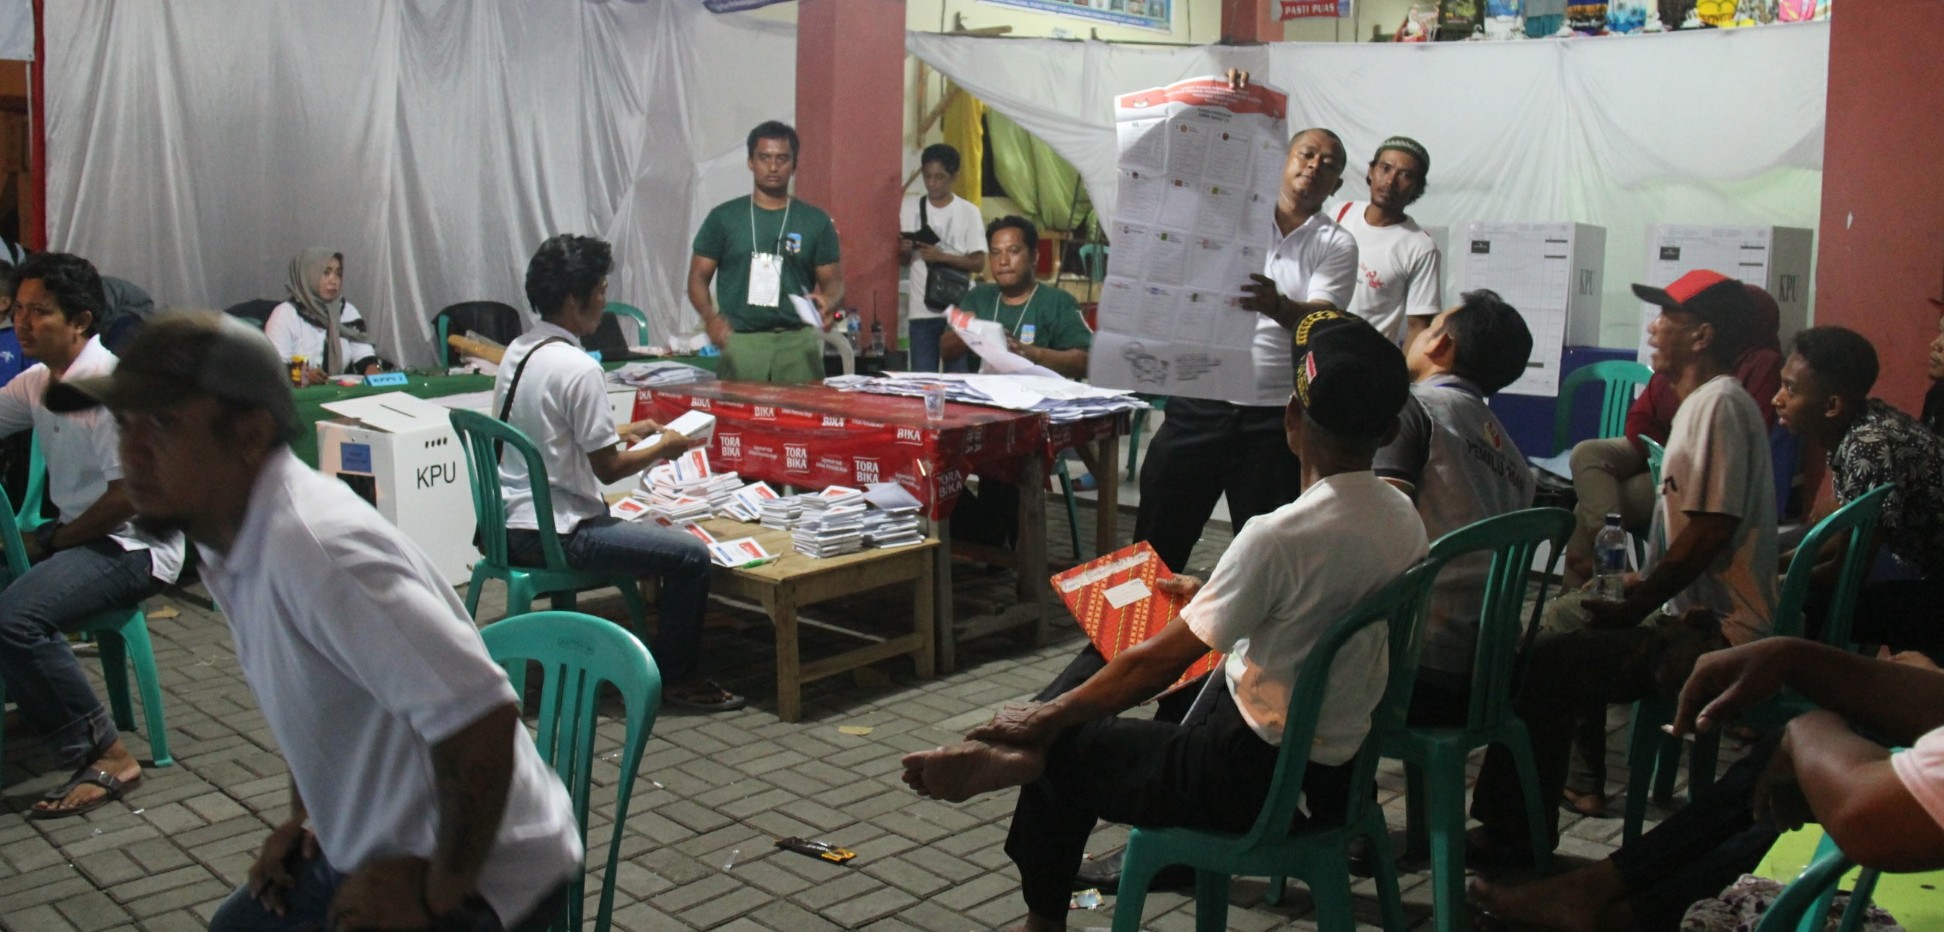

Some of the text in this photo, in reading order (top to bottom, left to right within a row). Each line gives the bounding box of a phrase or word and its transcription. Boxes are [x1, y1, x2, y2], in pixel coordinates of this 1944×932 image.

[1285, 3, 1335, 15] PASTI PUAS
[1578, 268, 1596, 296] KPU
[1779, 273, 1800, 303] KPU
[754, 406, 775, 417] BIKA
[821, 416, 845, 427] BIKA
[896, 428, 921, 441] BIKA
[720, 436, 741, 447] TORA
[721, 446, 741, 457] BIKA
[785, 446, 807, 459] TORA
[786, 457, 807, 469] BIKA
[855, 460, 879, 473] TORA
[416, 461, 457, 490] KPU
[856, 471, 879, 484] BIKA
[937, 469, 962, 486] TORA
[938, 480, 963, 498] BIKA
